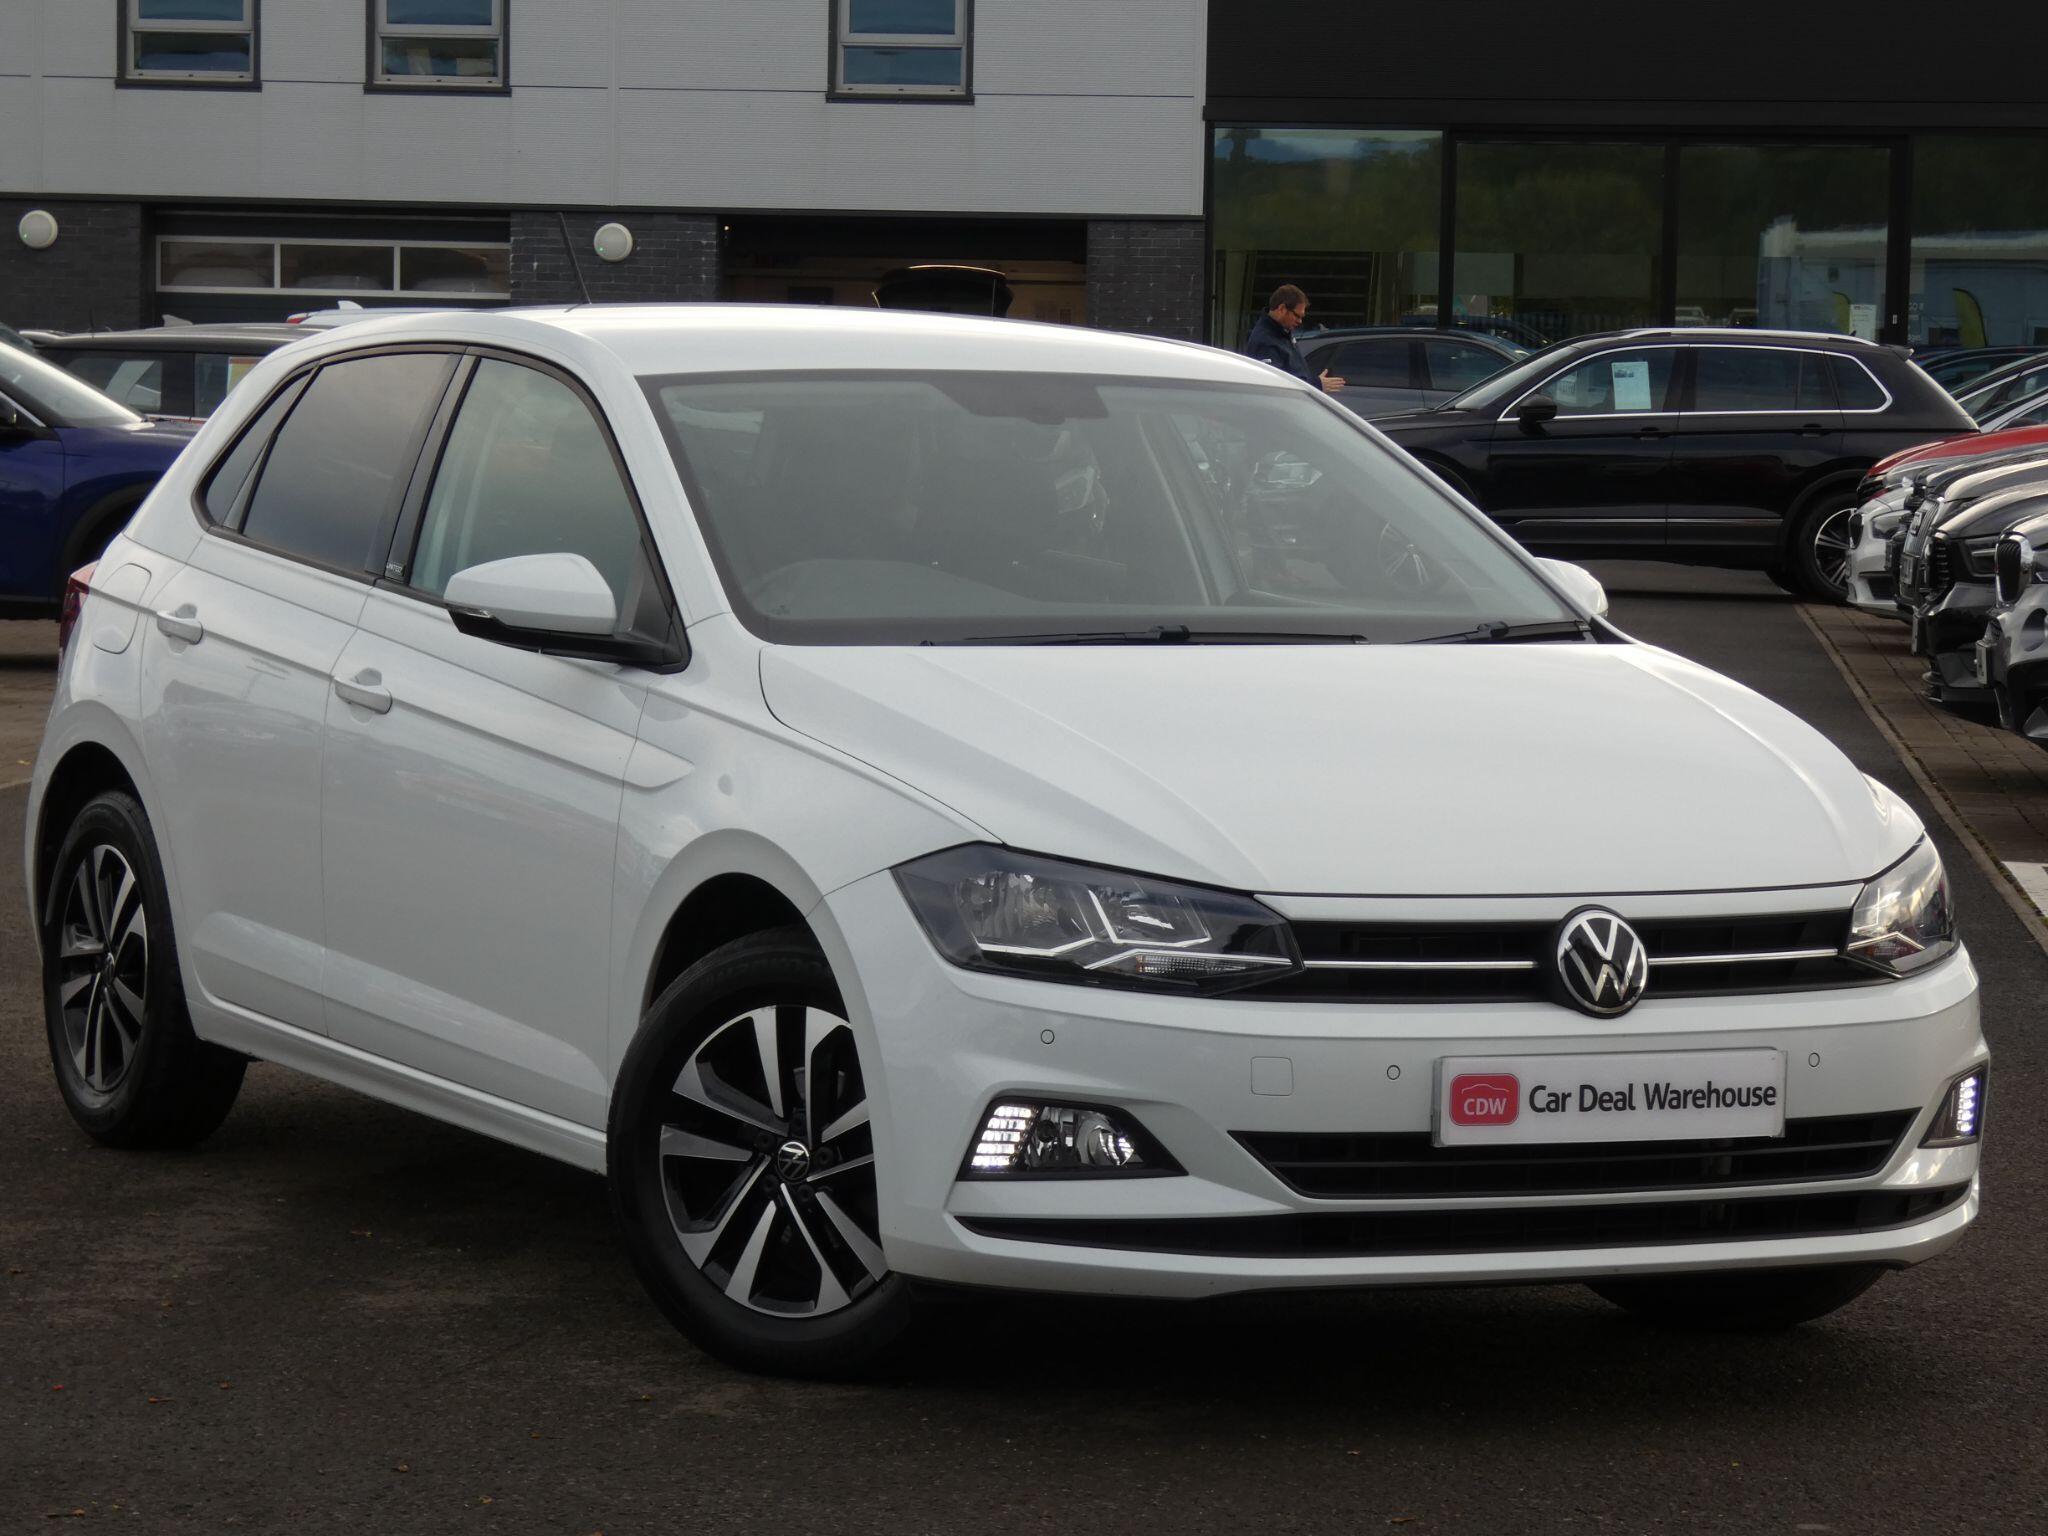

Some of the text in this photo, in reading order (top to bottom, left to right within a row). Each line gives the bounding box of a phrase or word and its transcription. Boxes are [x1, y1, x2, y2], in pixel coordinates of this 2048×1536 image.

[1463, 1097, 1508, 1116] CDW
[1528, 1080, 1778, 1114] Car Deal Warehouse
